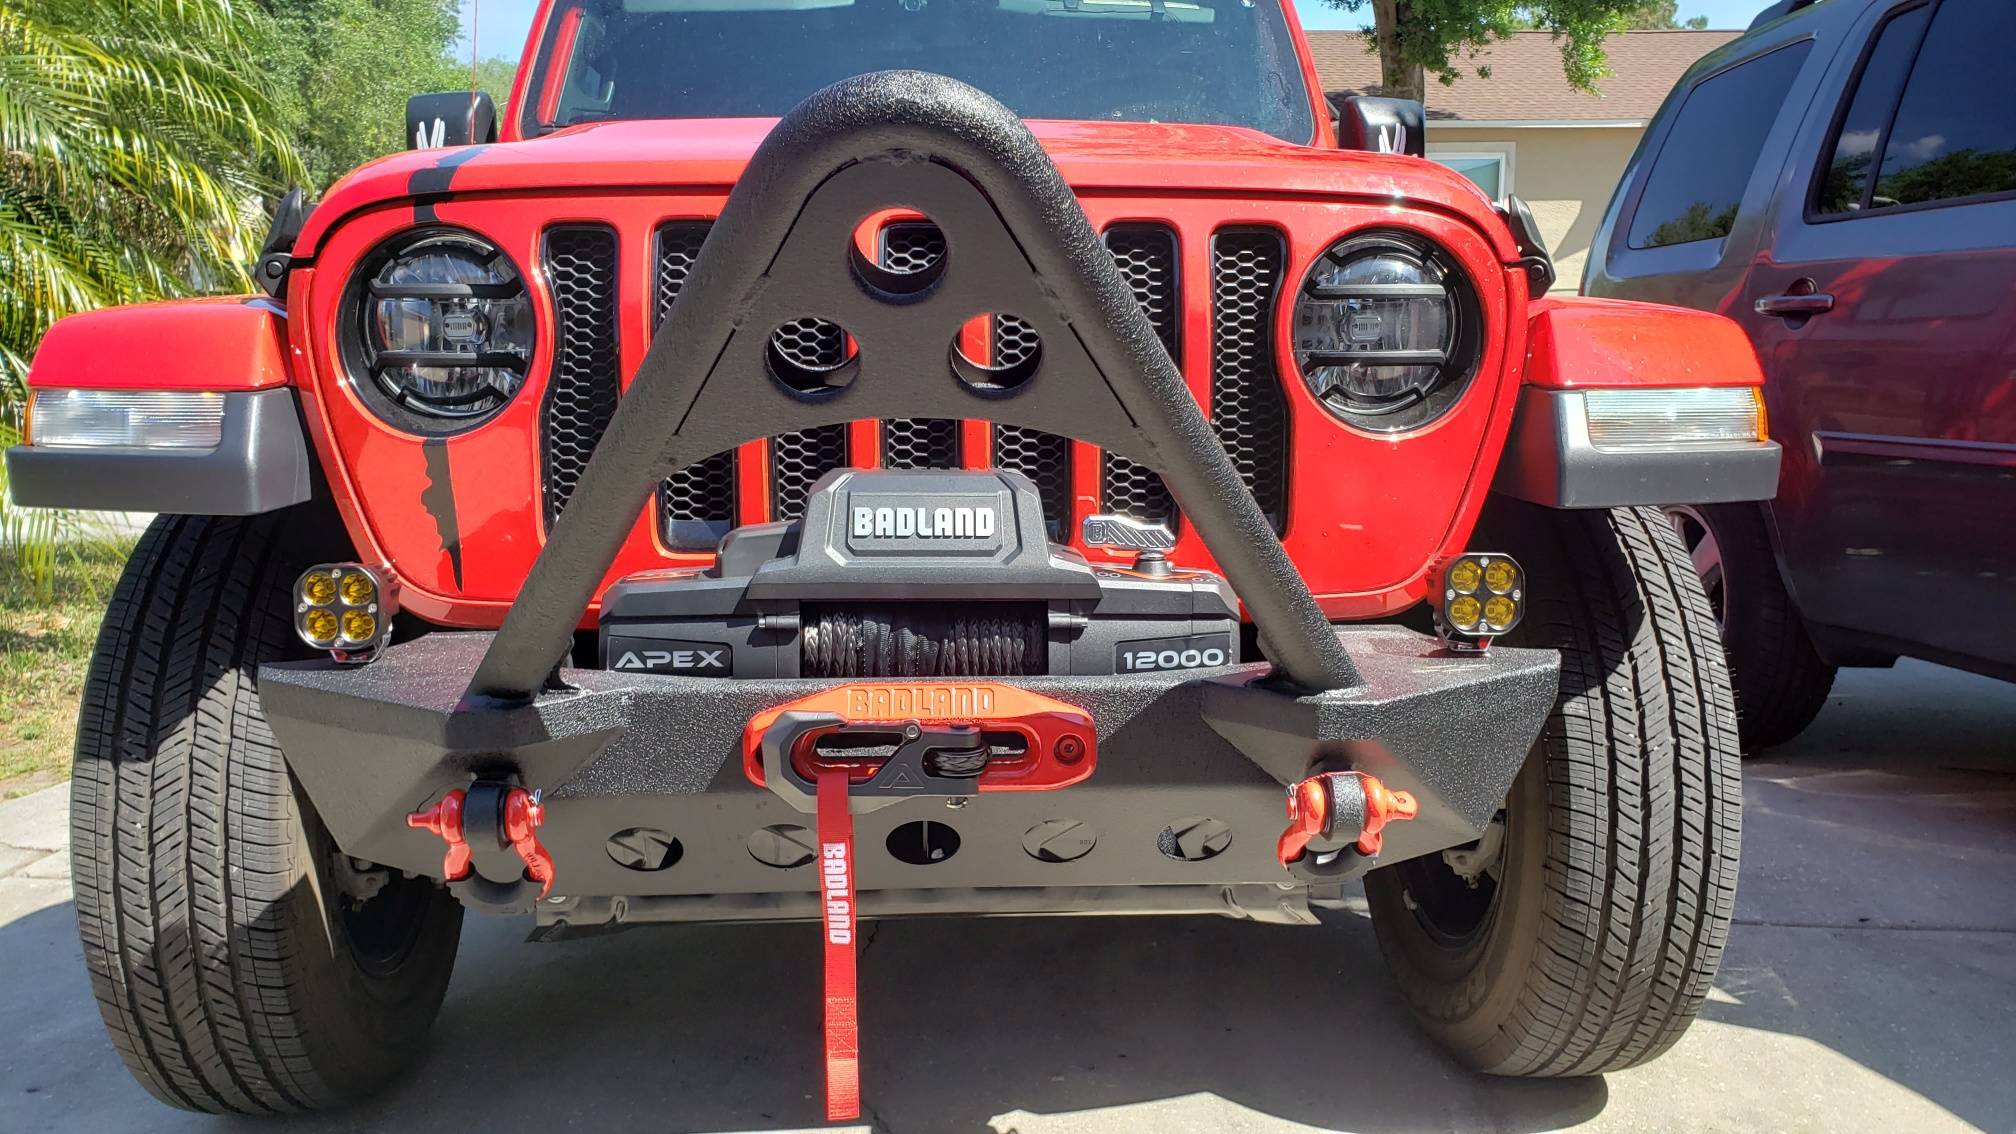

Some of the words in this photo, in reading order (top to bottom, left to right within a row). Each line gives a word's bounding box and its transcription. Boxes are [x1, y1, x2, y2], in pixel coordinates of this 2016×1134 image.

[853, 507, 995, 538] BADLAND
[614, 650, 725, 669] APEX
[1122, 648, 1225, 670] 12000
[847, 688, 995, 718] BADLAND
[823, 842, 852, 945] BADLAND
